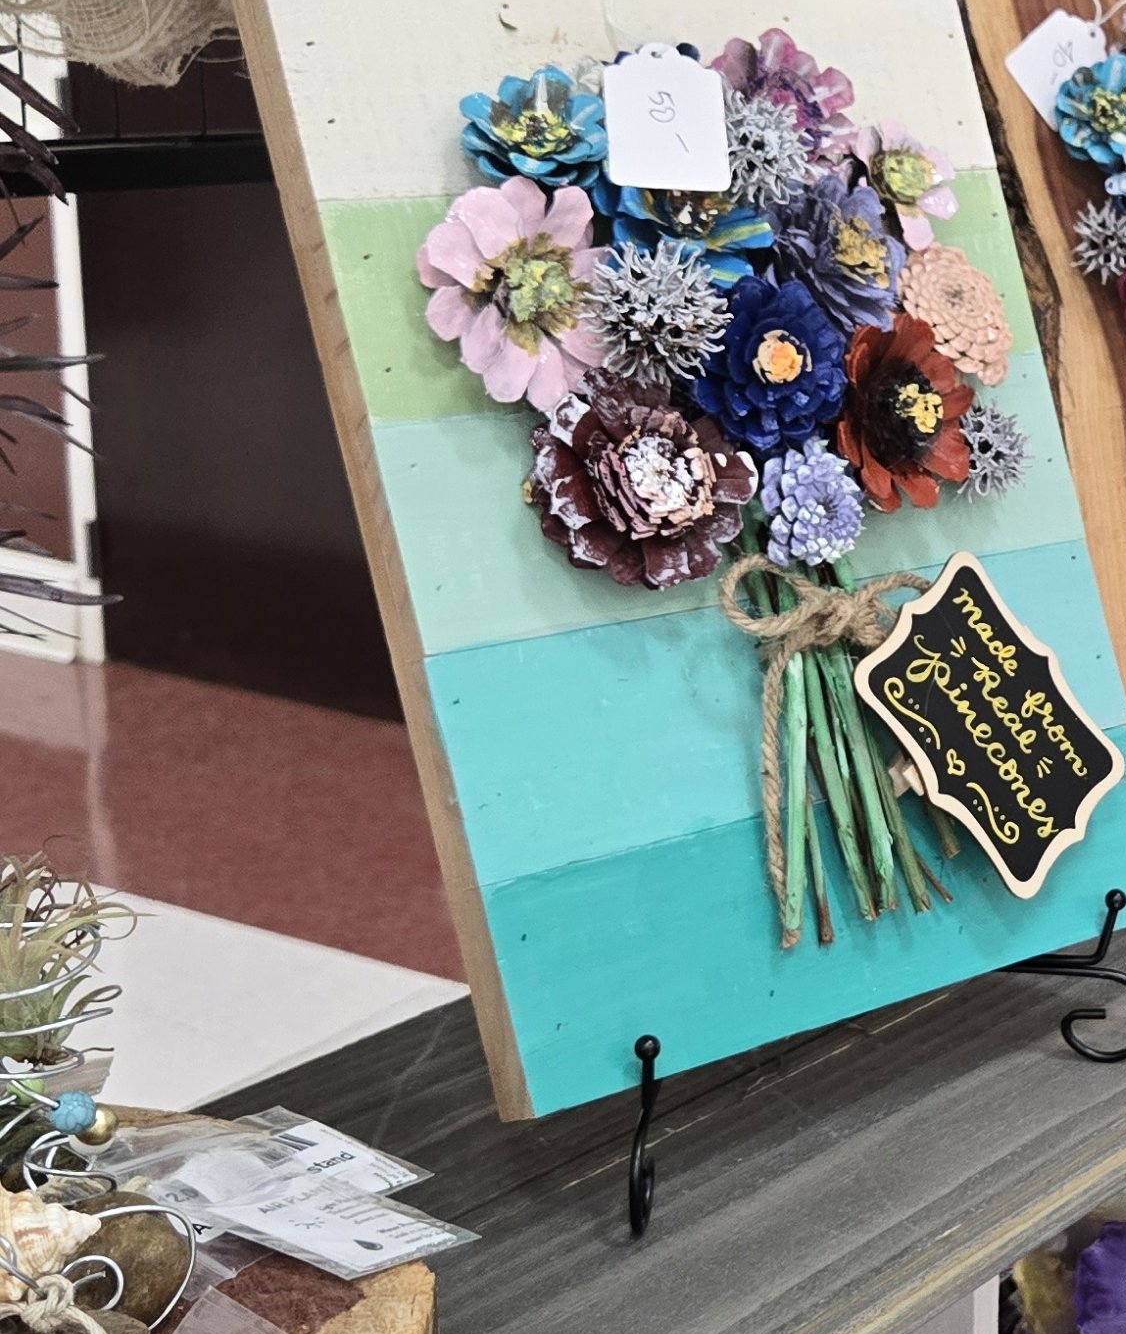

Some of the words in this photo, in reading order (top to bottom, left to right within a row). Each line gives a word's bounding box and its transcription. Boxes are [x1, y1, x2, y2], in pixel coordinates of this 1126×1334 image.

[906, 634, 1059, 838] Pinecones
[952, 588, 1018, 677] made
[1021, 689, 1088, 777] from
[971, 657, 1037, 754] Real
[307, 1151, 356, 1174] stand
